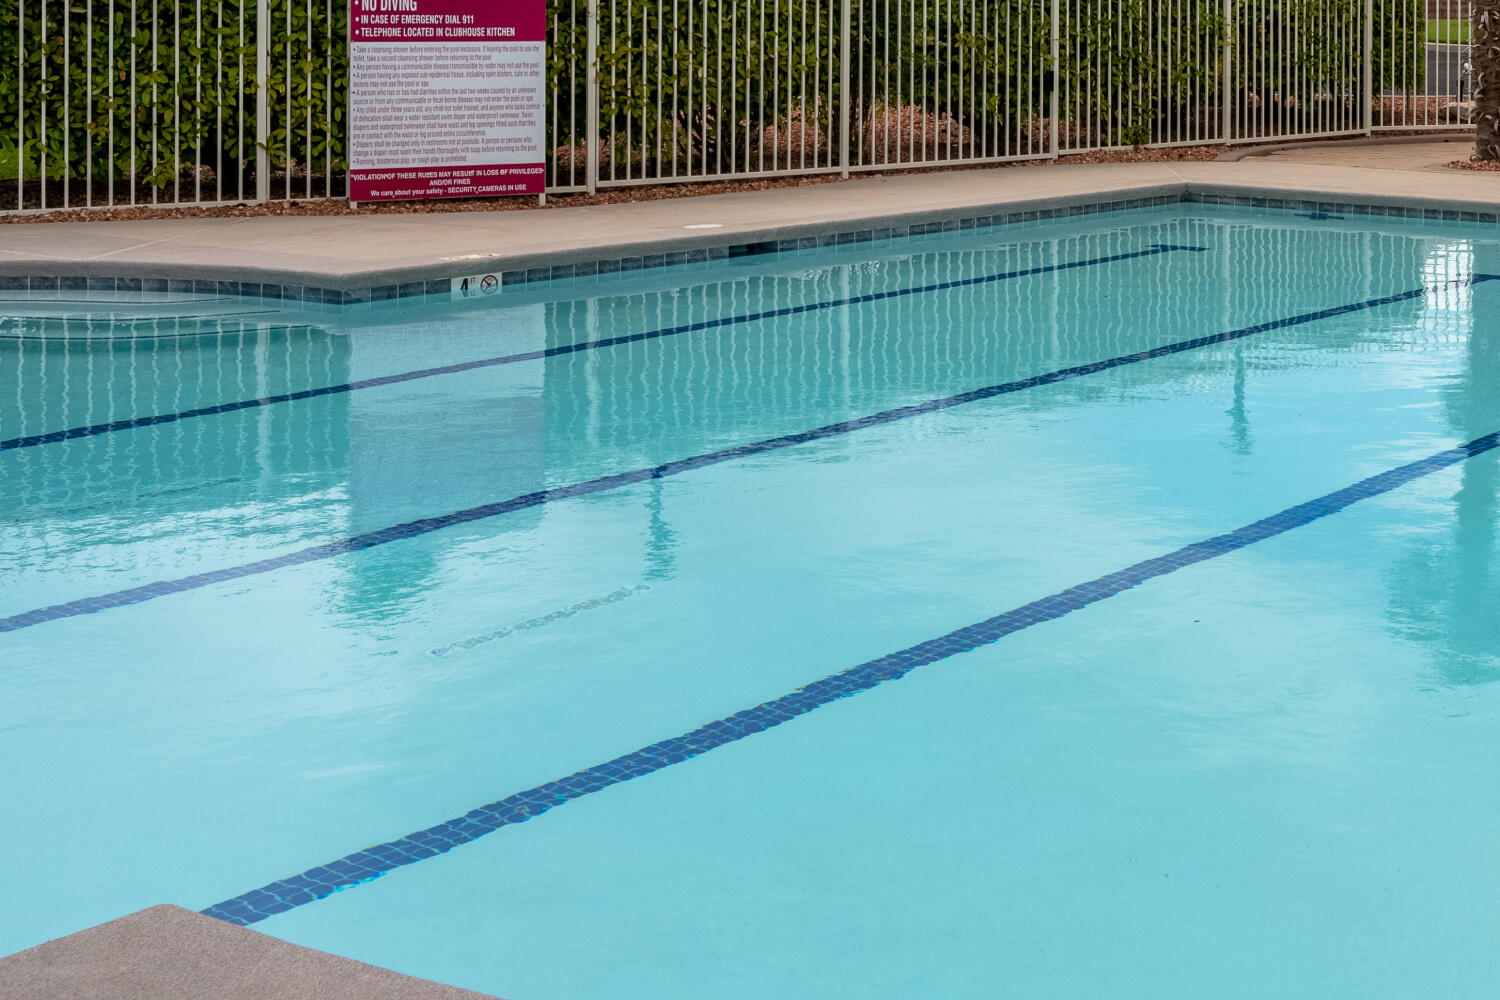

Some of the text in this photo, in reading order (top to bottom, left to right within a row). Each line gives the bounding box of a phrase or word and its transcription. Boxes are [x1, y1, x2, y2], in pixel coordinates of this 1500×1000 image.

[361, 15, 474, 24] IN CASE OF EMERGENCY DIAL 911
[361, 28, 515, 36] TELEPHONE LOCATED IN CLUBHOUSE KITCHEN
[426, 188, 443, 196] safety
